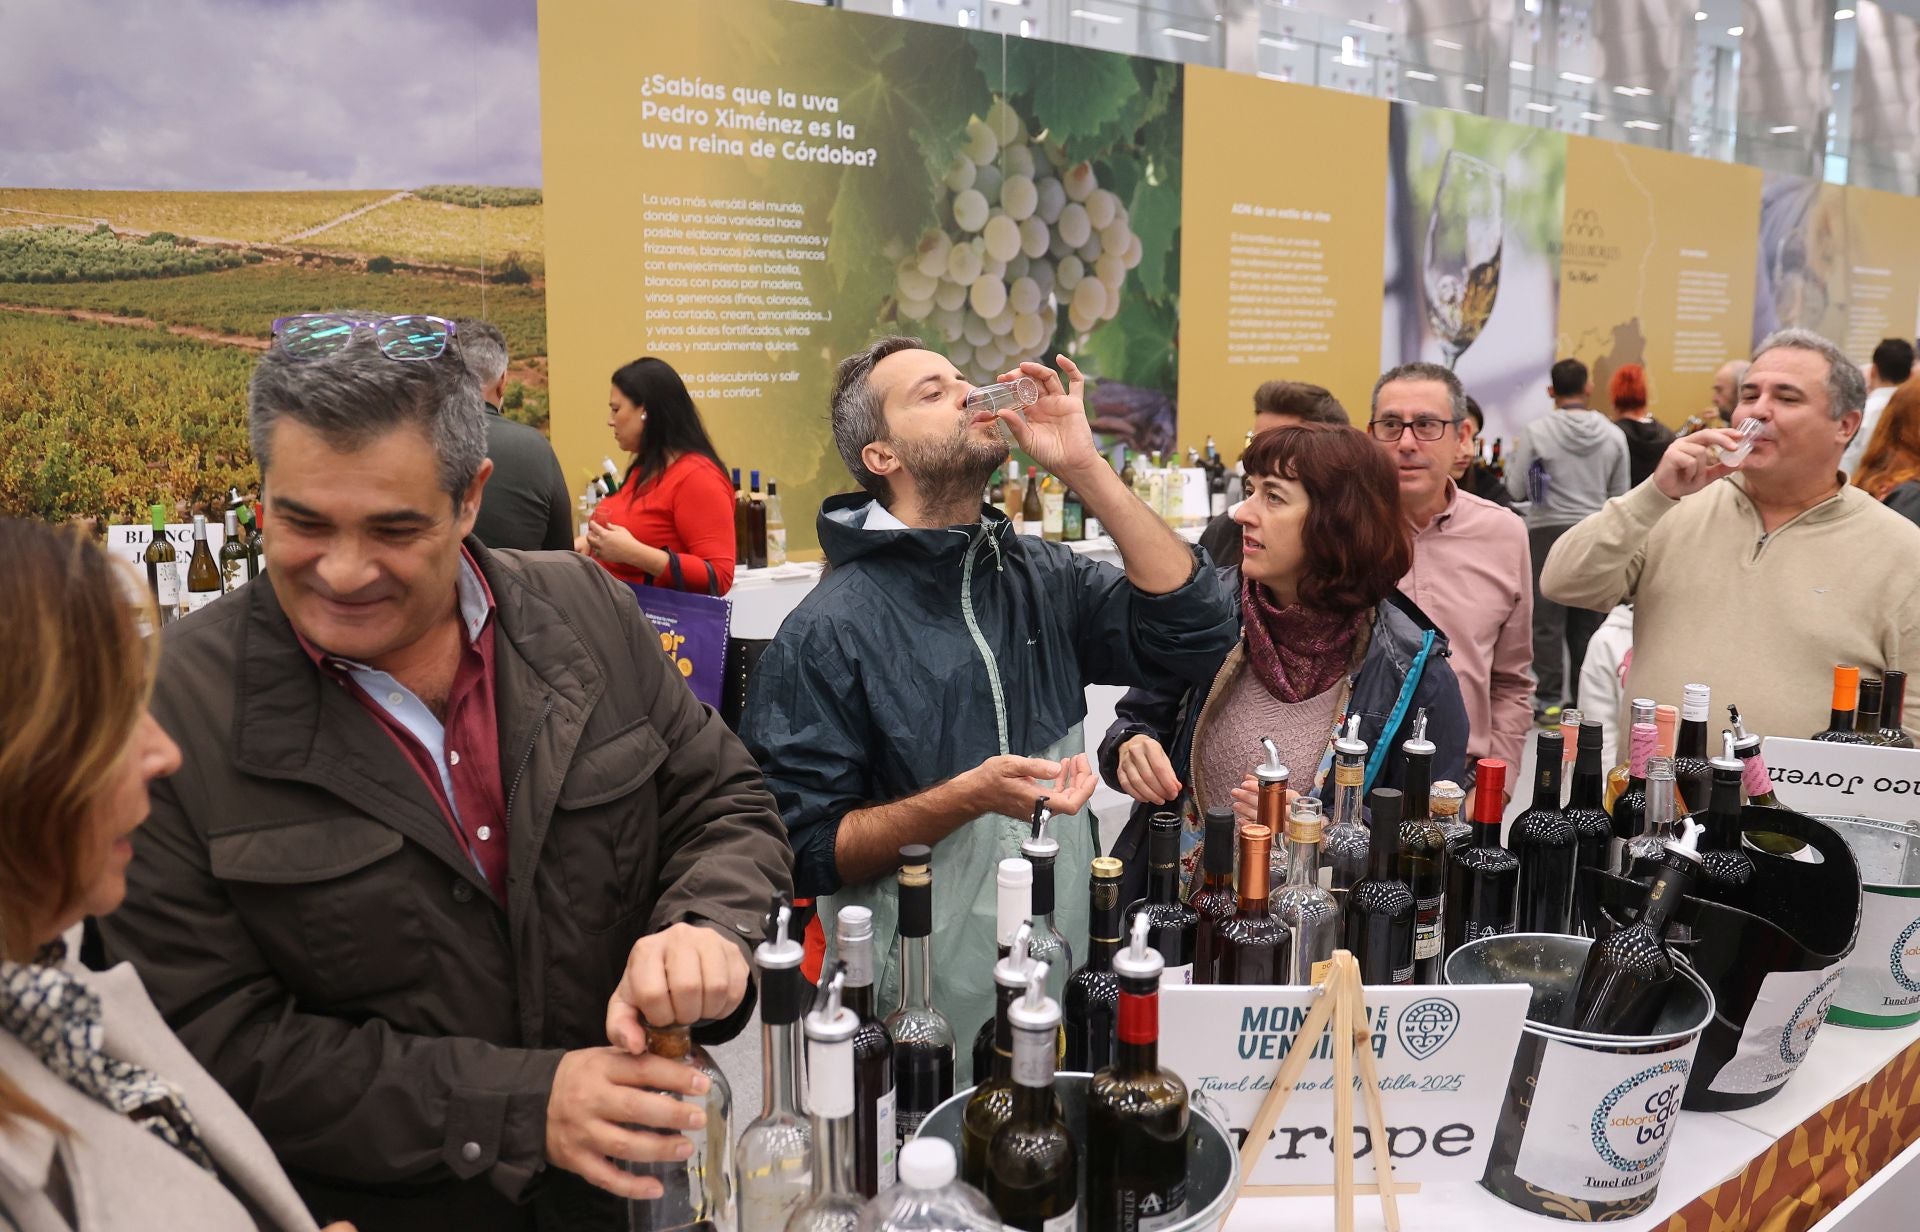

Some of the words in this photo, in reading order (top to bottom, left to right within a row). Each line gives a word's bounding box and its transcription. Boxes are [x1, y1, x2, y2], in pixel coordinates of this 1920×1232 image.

[641, 74, 725, 100] ¿Sabías
[732, 87, 771, 106] que
[778, 88, 796, 108] la
[802, 94, 838, 113] uva
[642, 101, 708, 126] Pedro
[716, 108, 802, 135] Ximénez
[808, 121, 830, 137] es
[837, 120, 855, 140] la
[642, 133, 682, 150] uva
[689, 134, 743, 155] reina
[750, 138, 775, 158] de
[782, 140, 877, 167] Córdoba?
[644, 193, 658, 204] La
[661, 196, 681, 206] uva
[684, 196, 706, 207] más
[710, 198, 747, 209] versátil
[750, 199, 765, 209] del
[767, 202, 804, 214] mundo,
[644, 210, 679, 221] donde
[683, 213, 702, 223] una
[705, 213, 727, 223] sola
[730, 215, 775, 227] variedad
[778, 217, 802, 228] hace
[644, 228, 683, 240] posible
[687, 229, 731, 239] elaborar
[734, 231, 760, 241] vinos
[763, 233, 820, 245] espumosos
[822, 235, 829, 247] y
[701, 245, 741, 256] blancos
[744, 246, 785, 259] jóvenes,
[787, 248, 826, 260] blancos
[645, 261, 665, 270] con
[668, 261, 747, 272] envejecimiento
[750, 264, 762, 274] en
[765, 263, 801, 275] botella,
[646, 276, 688, 287] blancos
[691, 278, 710, 288] con
[713, 278, 739, 288] paso
[742, 280, 759, 290] por
[762, 279, 804, 290] madera,
[646, 292, 674, 302] vinos
[677, 294, 732, 304] generosos
[735, 292, 765, 305] (finos,
[767, 294, 812, 306] olorosos,
[646, 308, 670, 319] palo
[673, 309, 718, 320] cortado,
[721, 310, 755, 320] cream,
[646, 326, 653, 337] y
[656, 325, 684, 335] vinos
[687, 325, 720, 335] dulces
[722, 324, 782, 335] fortificados,
[785, 325, 811, 335] vinos
[647, 341, 681, 351] dulces
[683, 342, 690, 353] y
[694, 341, 763, 351] naturalmente
[765, 341, 800, 351] dulces.
[770, 372, 777, 384] y
[780, 370, 800, 381] salir
[707, 387, 720, 397] de
[724, 387, 762, 397] confort.
[126, 529, 195, 543] BLNC
[132, 550, 193, 564] JEN
[1767, 766, 1864, 795] Joven
[1198, 1075, 1250, 1092] Túnel
[1420, 1074, 1465, 1090] 2025
